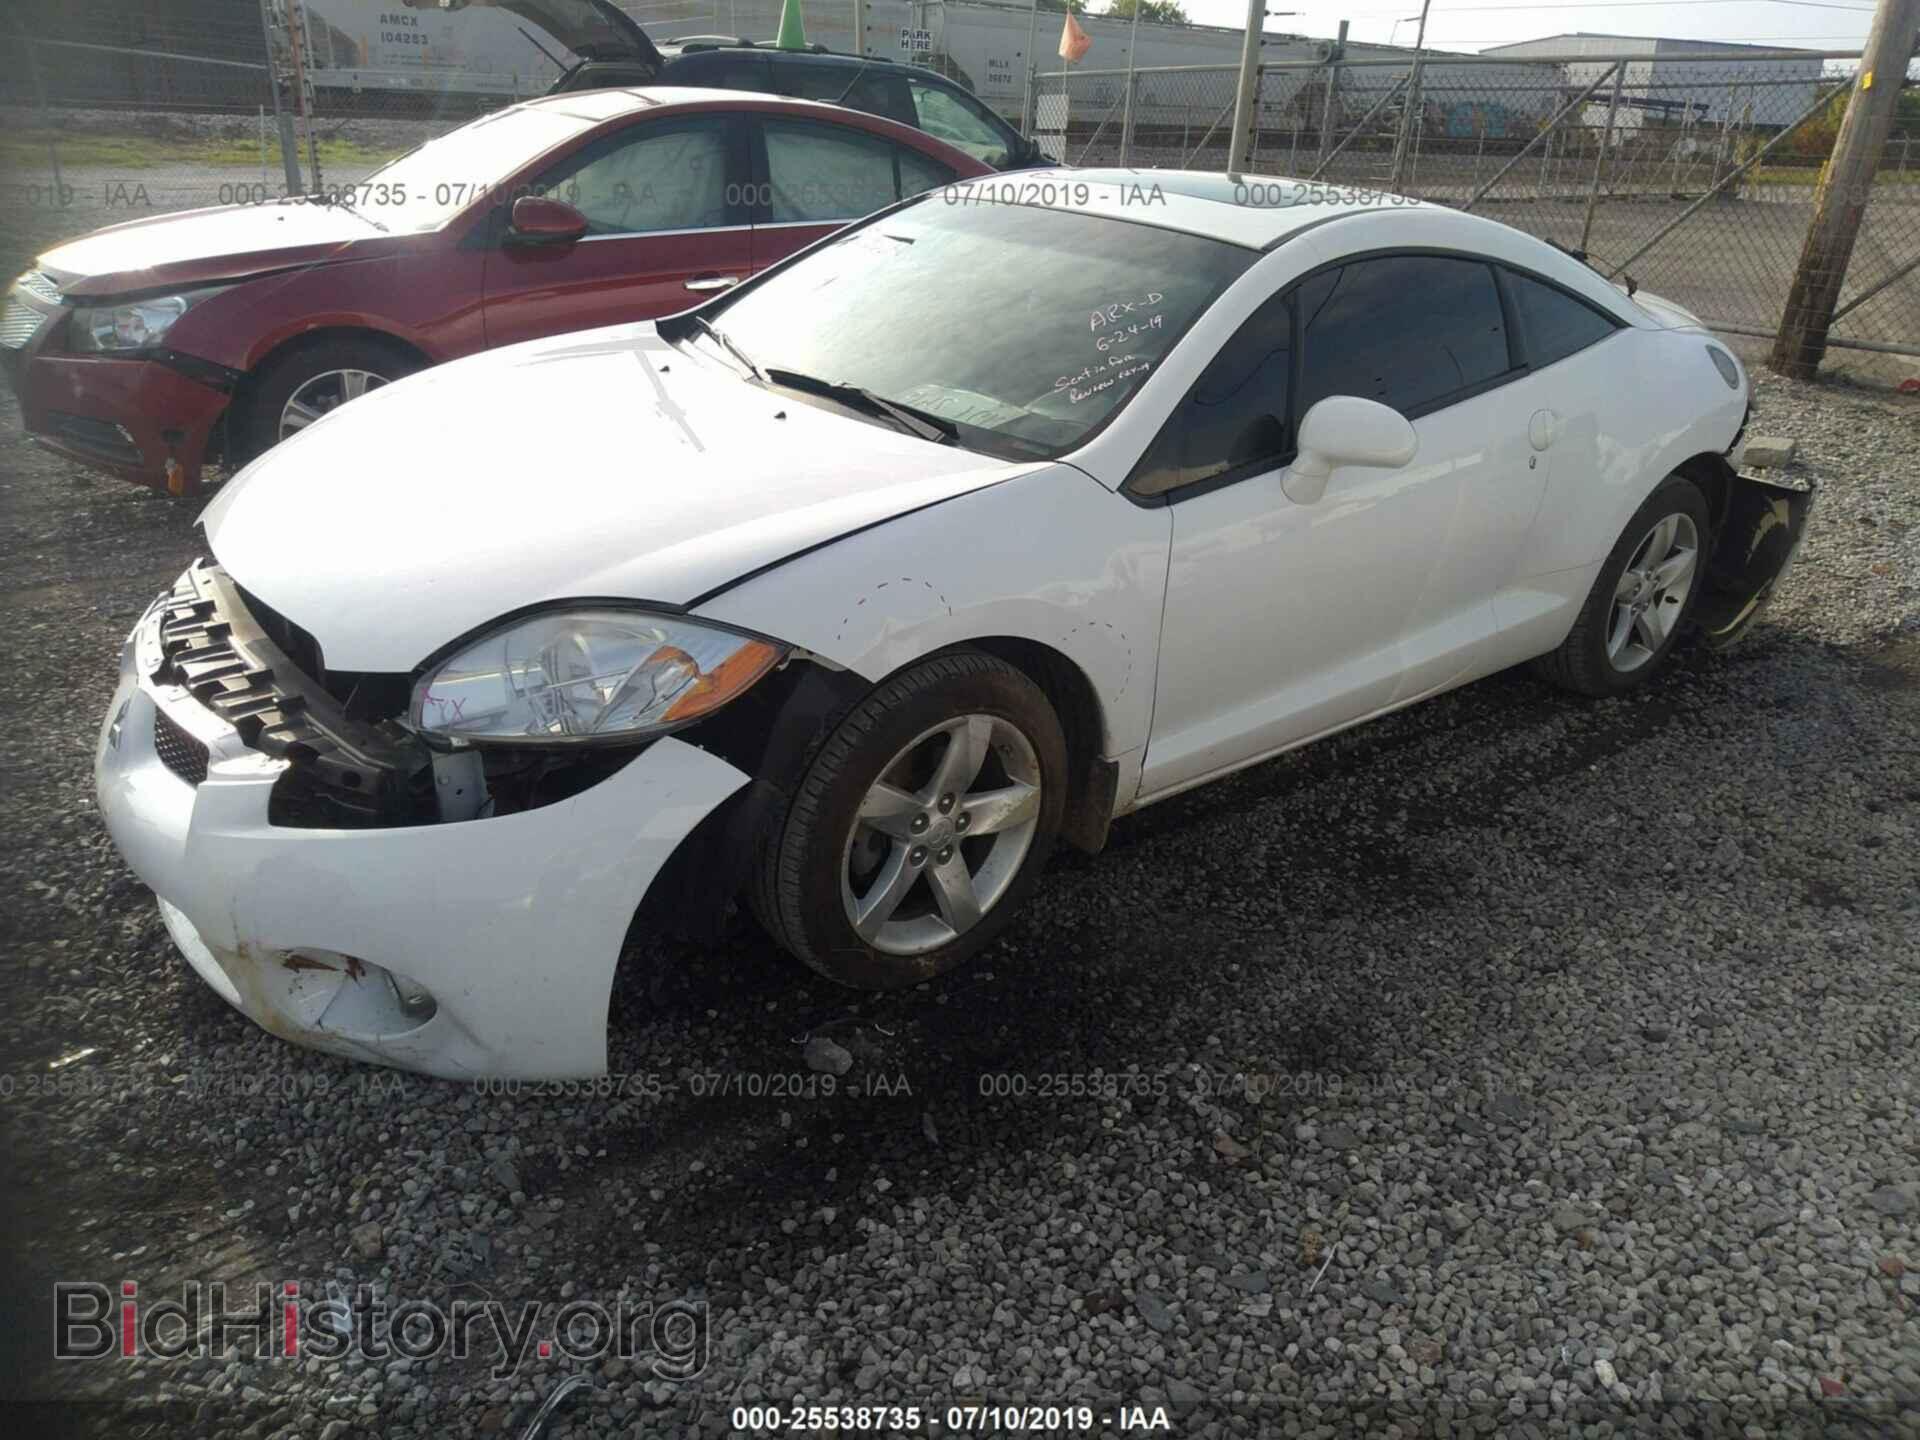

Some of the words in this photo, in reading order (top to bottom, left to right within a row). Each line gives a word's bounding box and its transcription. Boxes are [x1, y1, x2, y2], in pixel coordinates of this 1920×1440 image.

[380, 13, 418, 26] AMCX
[902, 29, 932, 40] PARK
[901, 40, 931, 50] HERE
